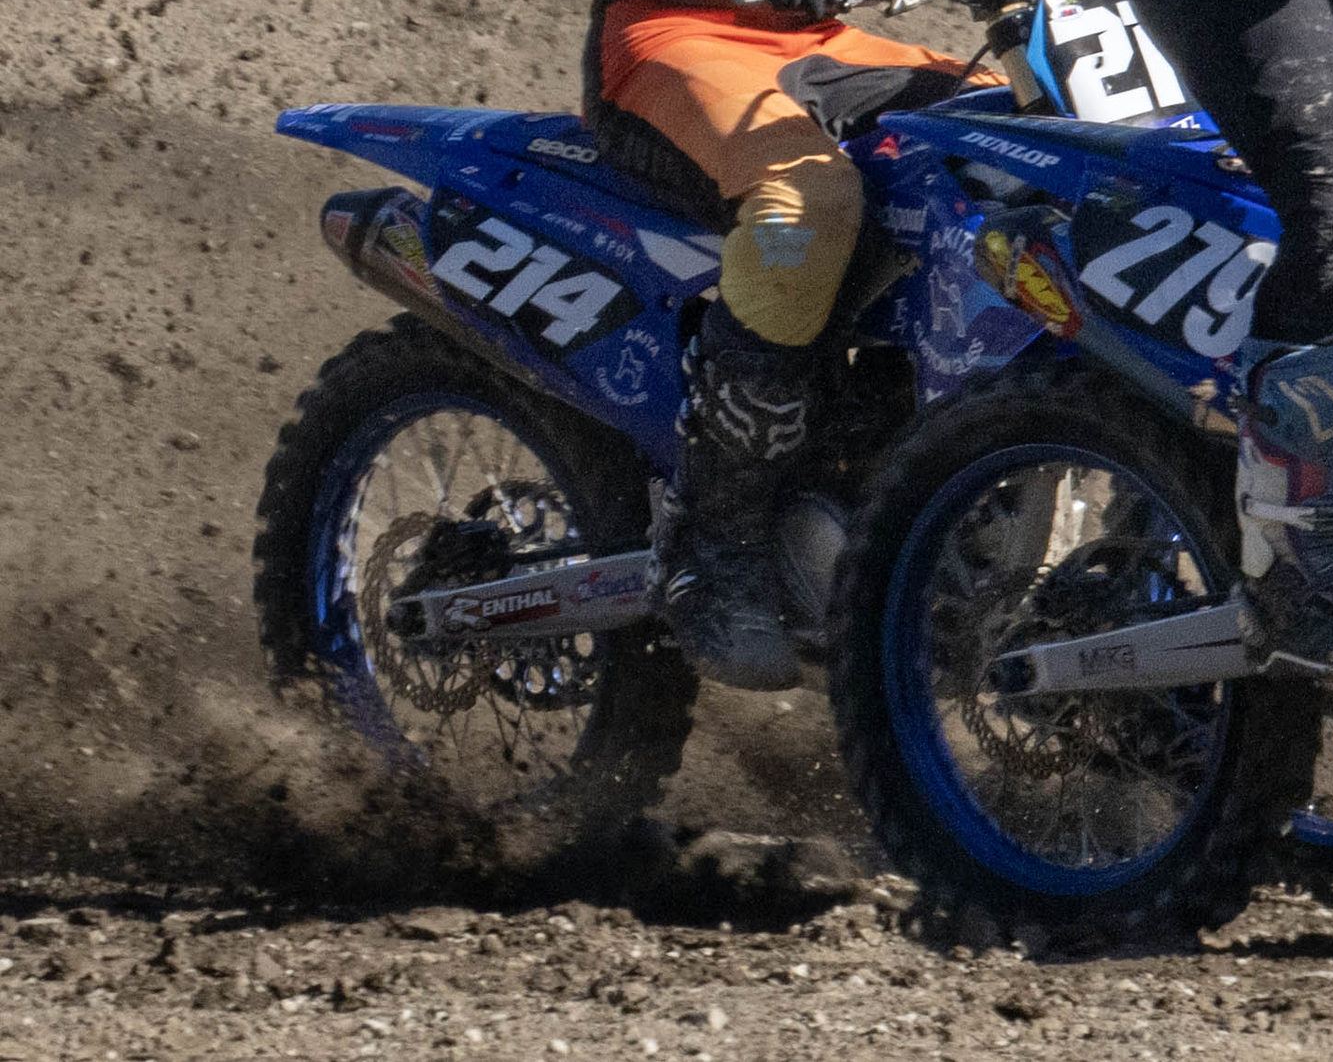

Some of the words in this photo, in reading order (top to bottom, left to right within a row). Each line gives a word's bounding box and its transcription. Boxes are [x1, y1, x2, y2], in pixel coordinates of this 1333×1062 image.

[1048, 0, 1188, 124] 21
[961, 131, 1061, 169] DUNLOP
[431, 217, 623, 348] 214
[1080, 205, 1277, 358] 279
